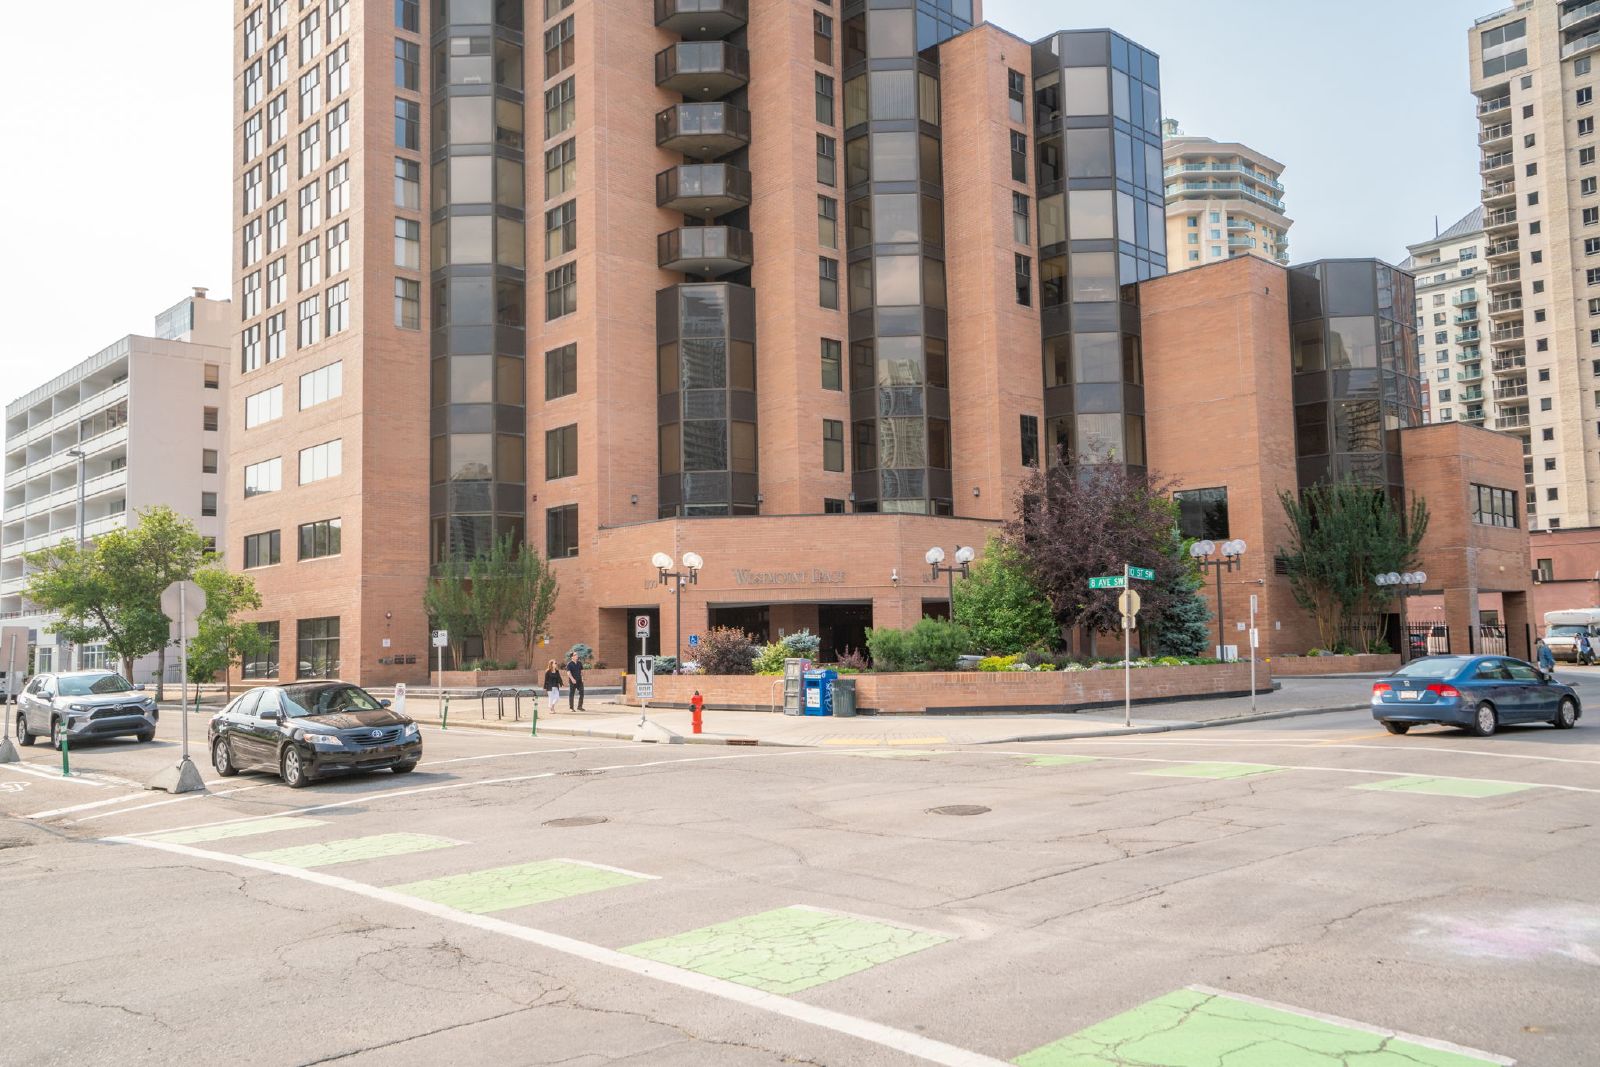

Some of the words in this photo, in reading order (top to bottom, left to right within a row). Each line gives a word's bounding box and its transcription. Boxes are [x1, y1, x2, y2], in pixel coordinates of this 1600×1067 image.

[1137, 569, 1143, 577] ST
[1145, 570, 1153, 578] SW
[1091, 579, 1096, 587] 8
[1098, 578, 1111, 587] AVE
[1114, 577, 1124, 586] SW
